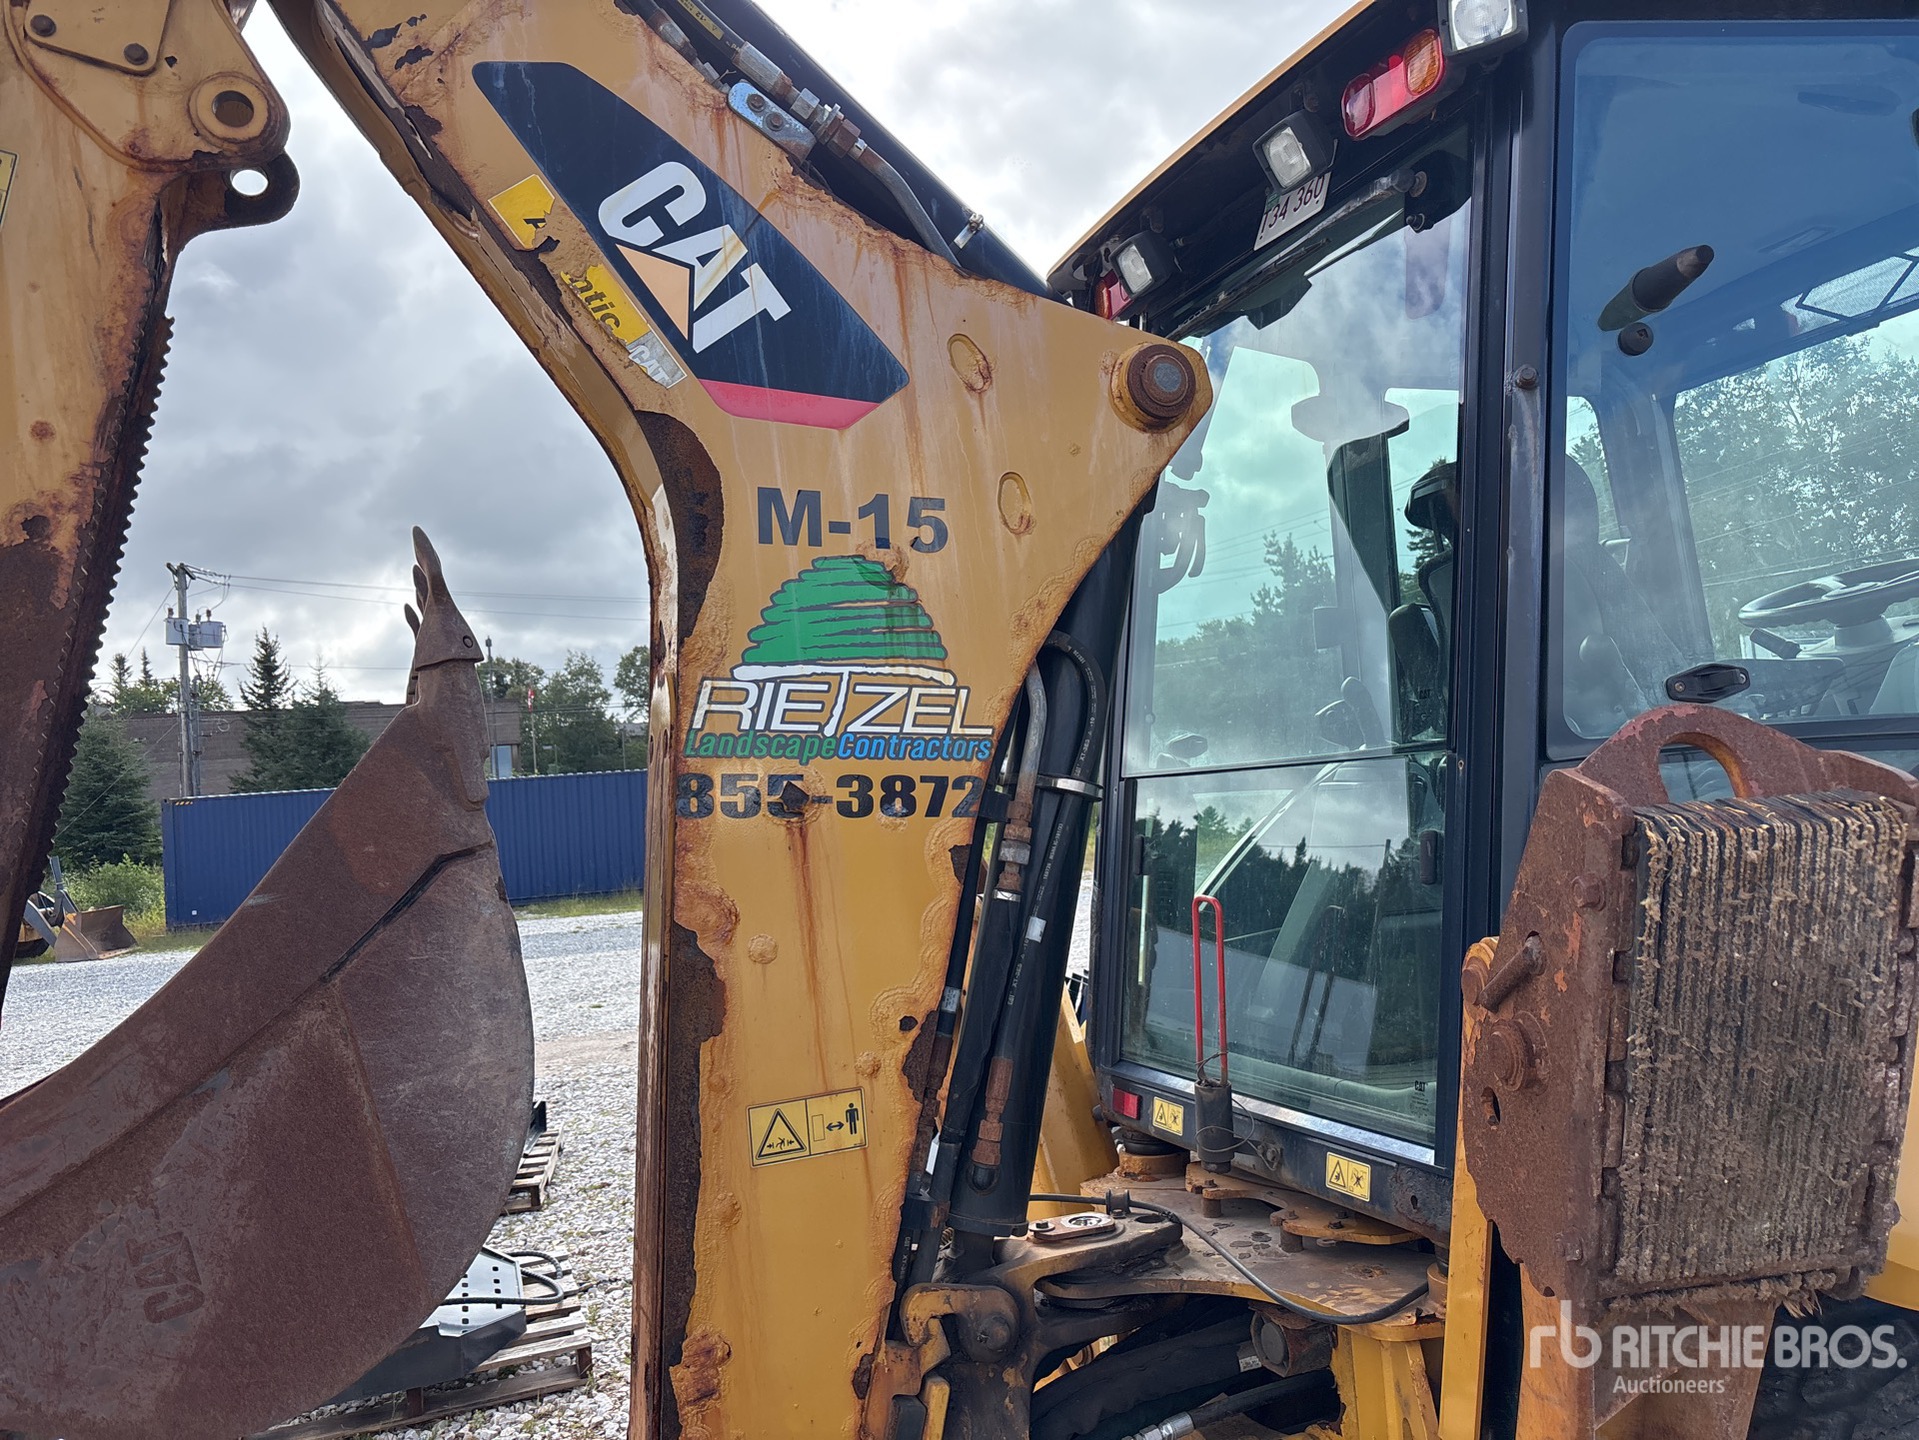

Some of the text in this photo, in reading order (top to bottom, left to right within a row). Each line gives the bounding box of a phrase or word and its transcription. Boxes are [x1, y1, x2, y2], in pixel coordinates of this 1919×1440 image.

[1293, 173, 1325, 213] 360
[598, 161, 792, 354] CAT
[757, 487, 948, 554] M-15
[691, 679, 994, 737] RIETZEL
[676, 773, 987, 819] 855-3872
[125, 1231, 205, 1324] CAT
